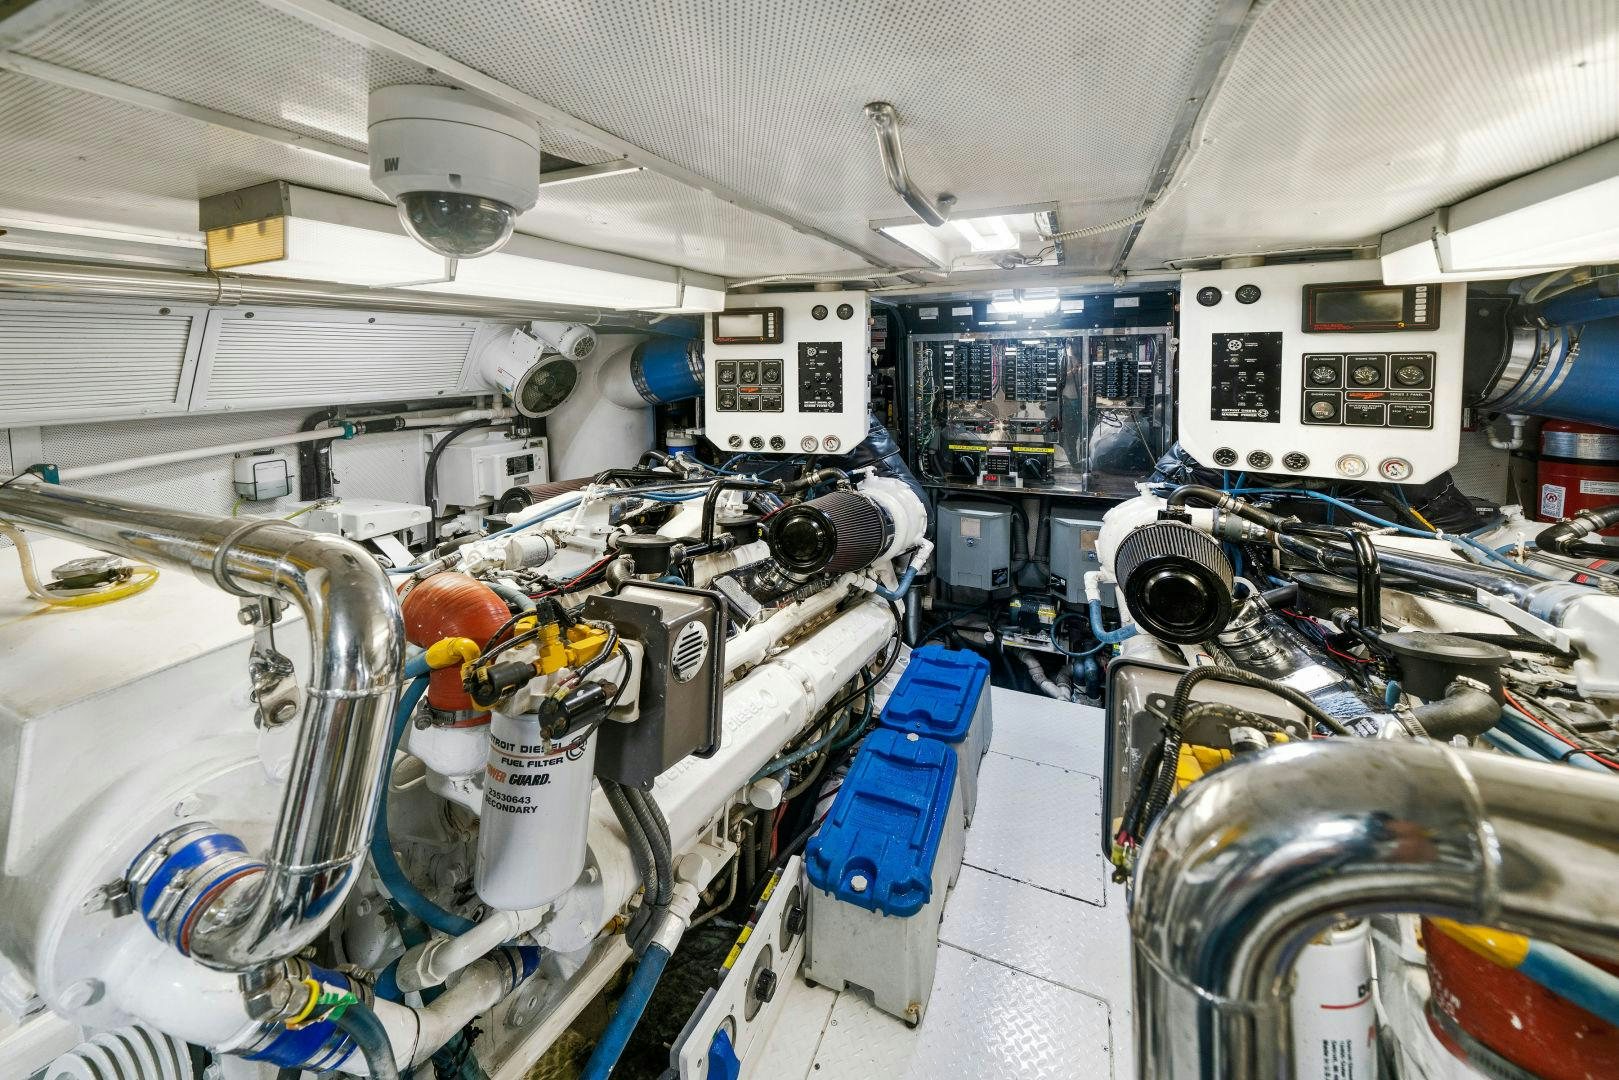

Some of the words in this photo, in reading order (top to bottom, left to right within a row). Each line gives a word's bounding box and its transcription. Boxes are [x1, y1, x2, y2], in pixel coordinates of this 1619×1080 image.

[501, 757, 525, 768] FUEL
[526, 757, 564, 768] FILTER
[488, 787, 531, 805] 23530643
